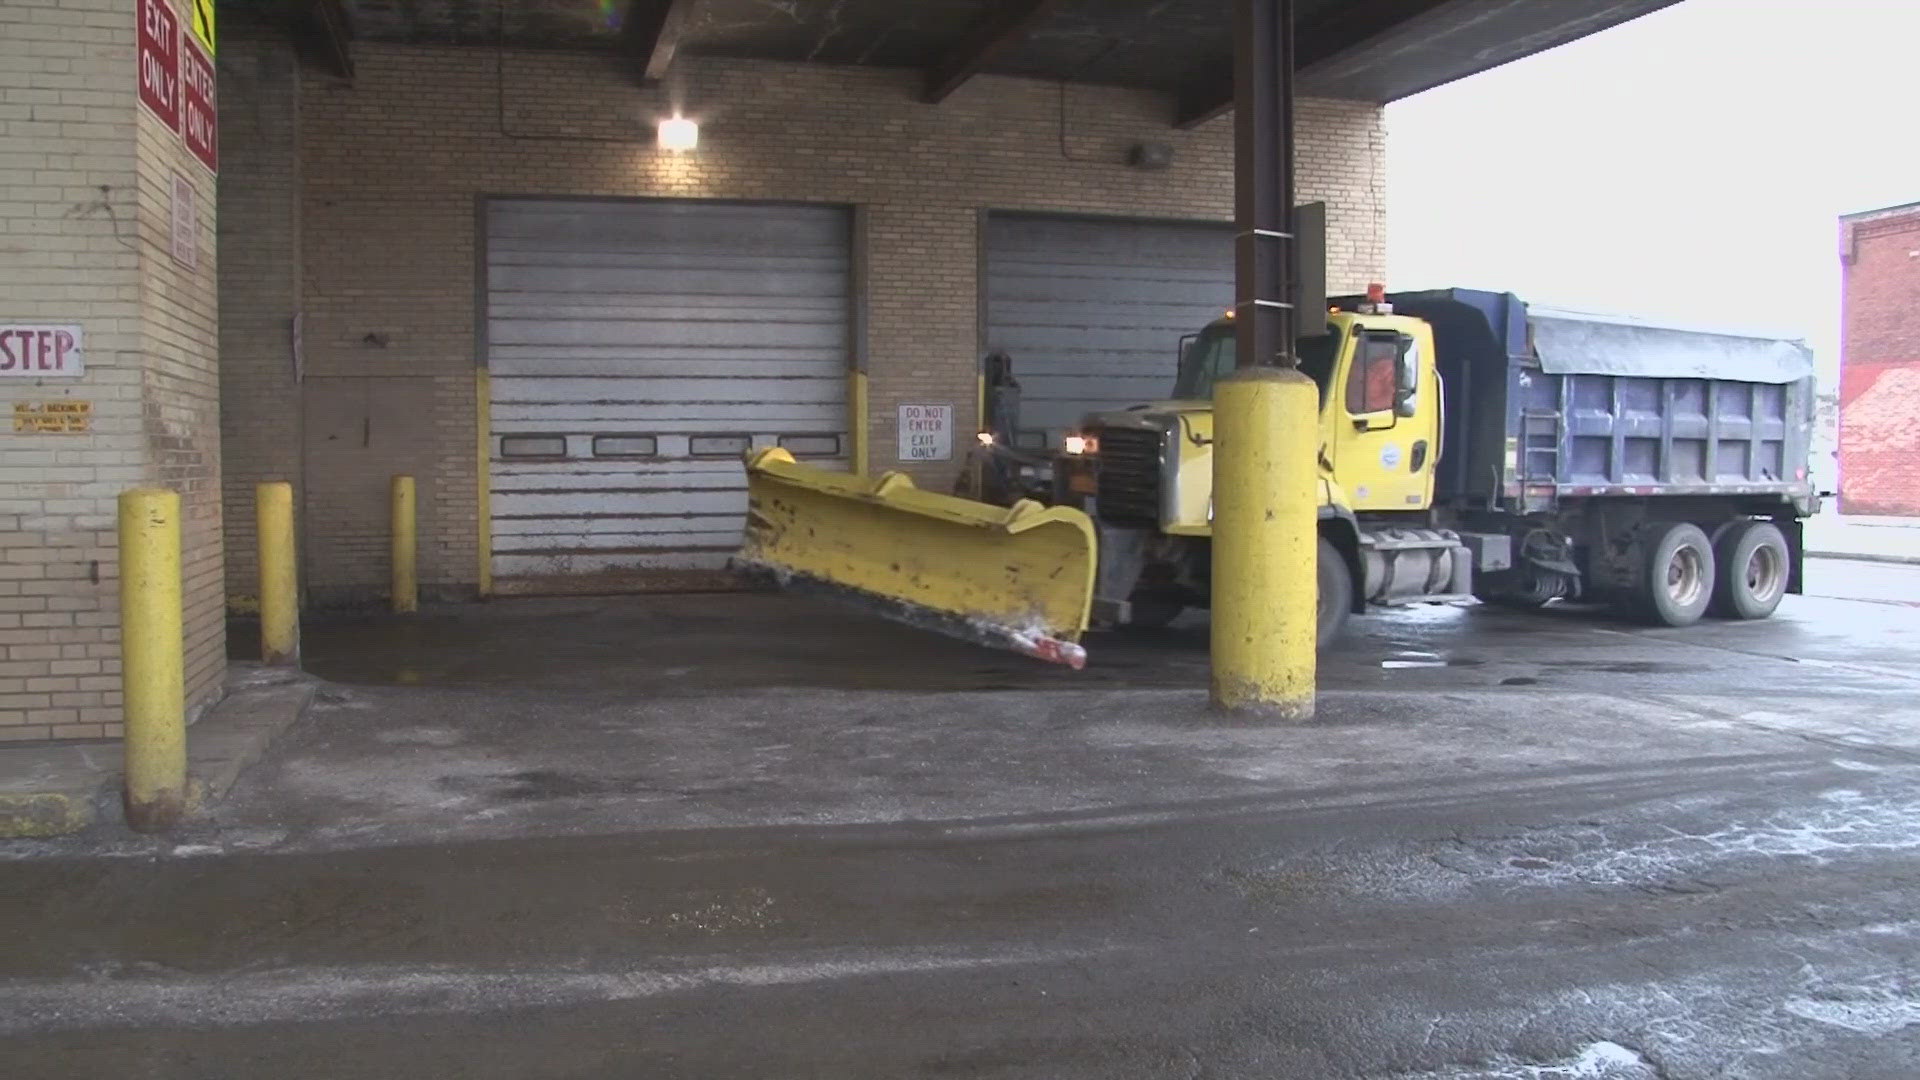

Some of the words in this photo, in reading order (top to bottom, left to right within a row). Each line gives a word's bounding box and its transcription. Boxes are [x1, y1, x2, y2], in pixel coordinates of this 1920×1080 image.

[145, 0, 171, 56] EXIT
[142, 48, 175, 112] ONLY
[185, 46, 214, 112] ENTER
[187, 100, 213, 153] ONLY
[0, 329, 74, 371] STEP
[906, 407, 920, 418] DO
[925, 407, 944, 418] NOT
[909, 419, 942, 431] ENTER
[911, 435, 934, 446] EXIT
[911, 447, 937, 458] ONLY
